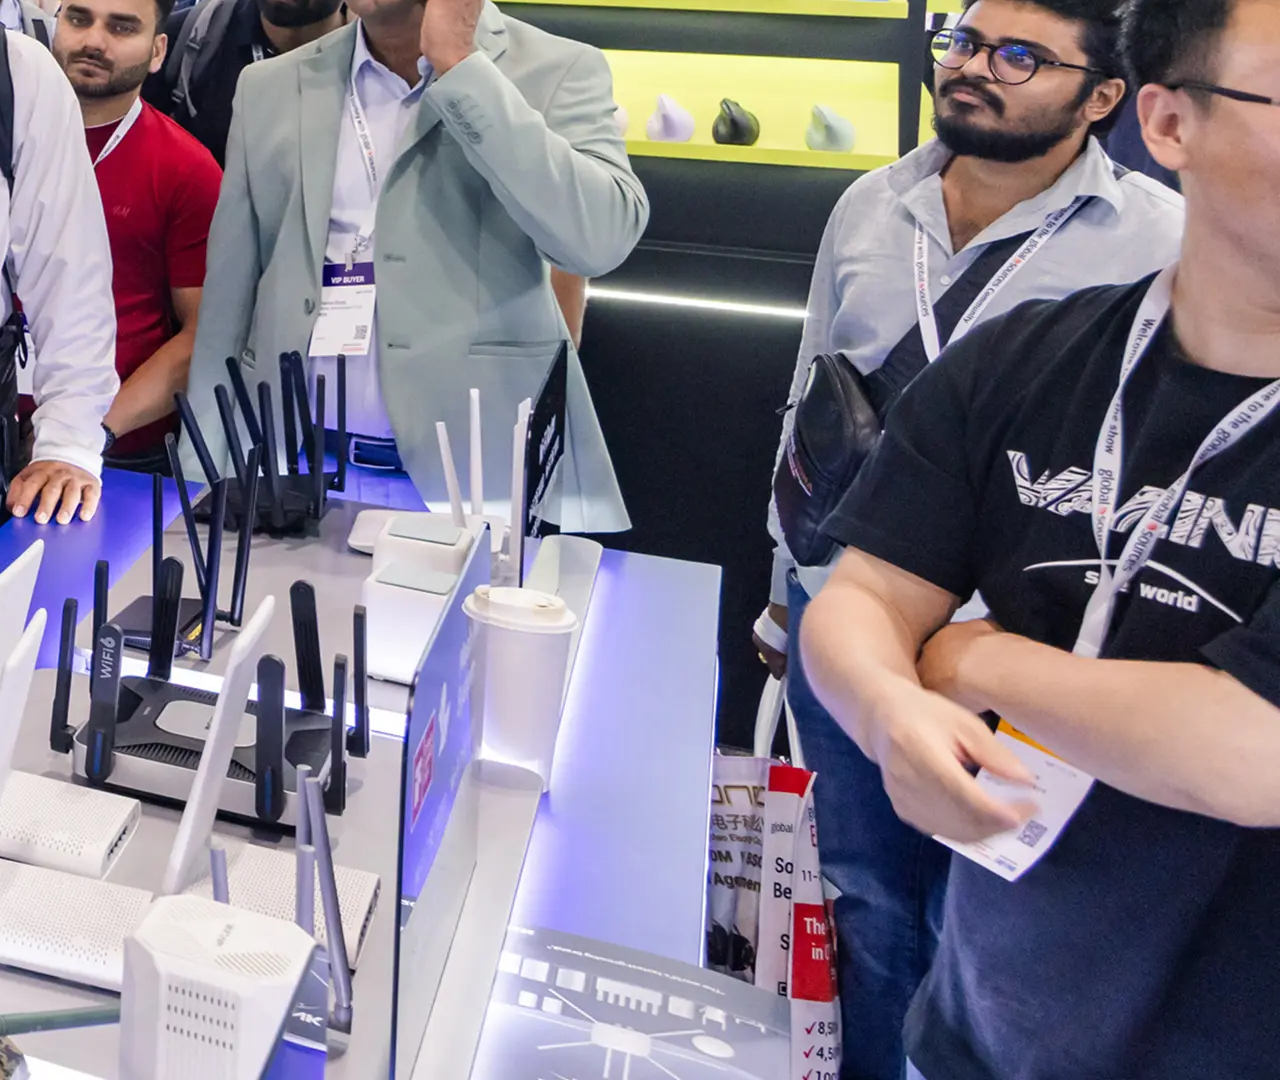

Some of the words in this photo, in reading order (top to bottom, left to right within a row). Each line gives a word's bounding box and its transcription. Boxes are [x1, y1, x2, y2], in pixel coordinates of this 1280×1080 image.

[331, 276, 342, 284] VIP
[343, 275, 365, 283] BUYER
[993, 262, 1018, 287] sources
[919, 288, 929, 317] sources
[1104, 424, 1119, 455] show
[1097, 468, 1113, 507] global
[1123, 527, 1153, 572] sources
[1140, 583, 1199, 612] world
[771, 823, 793, 833] global
